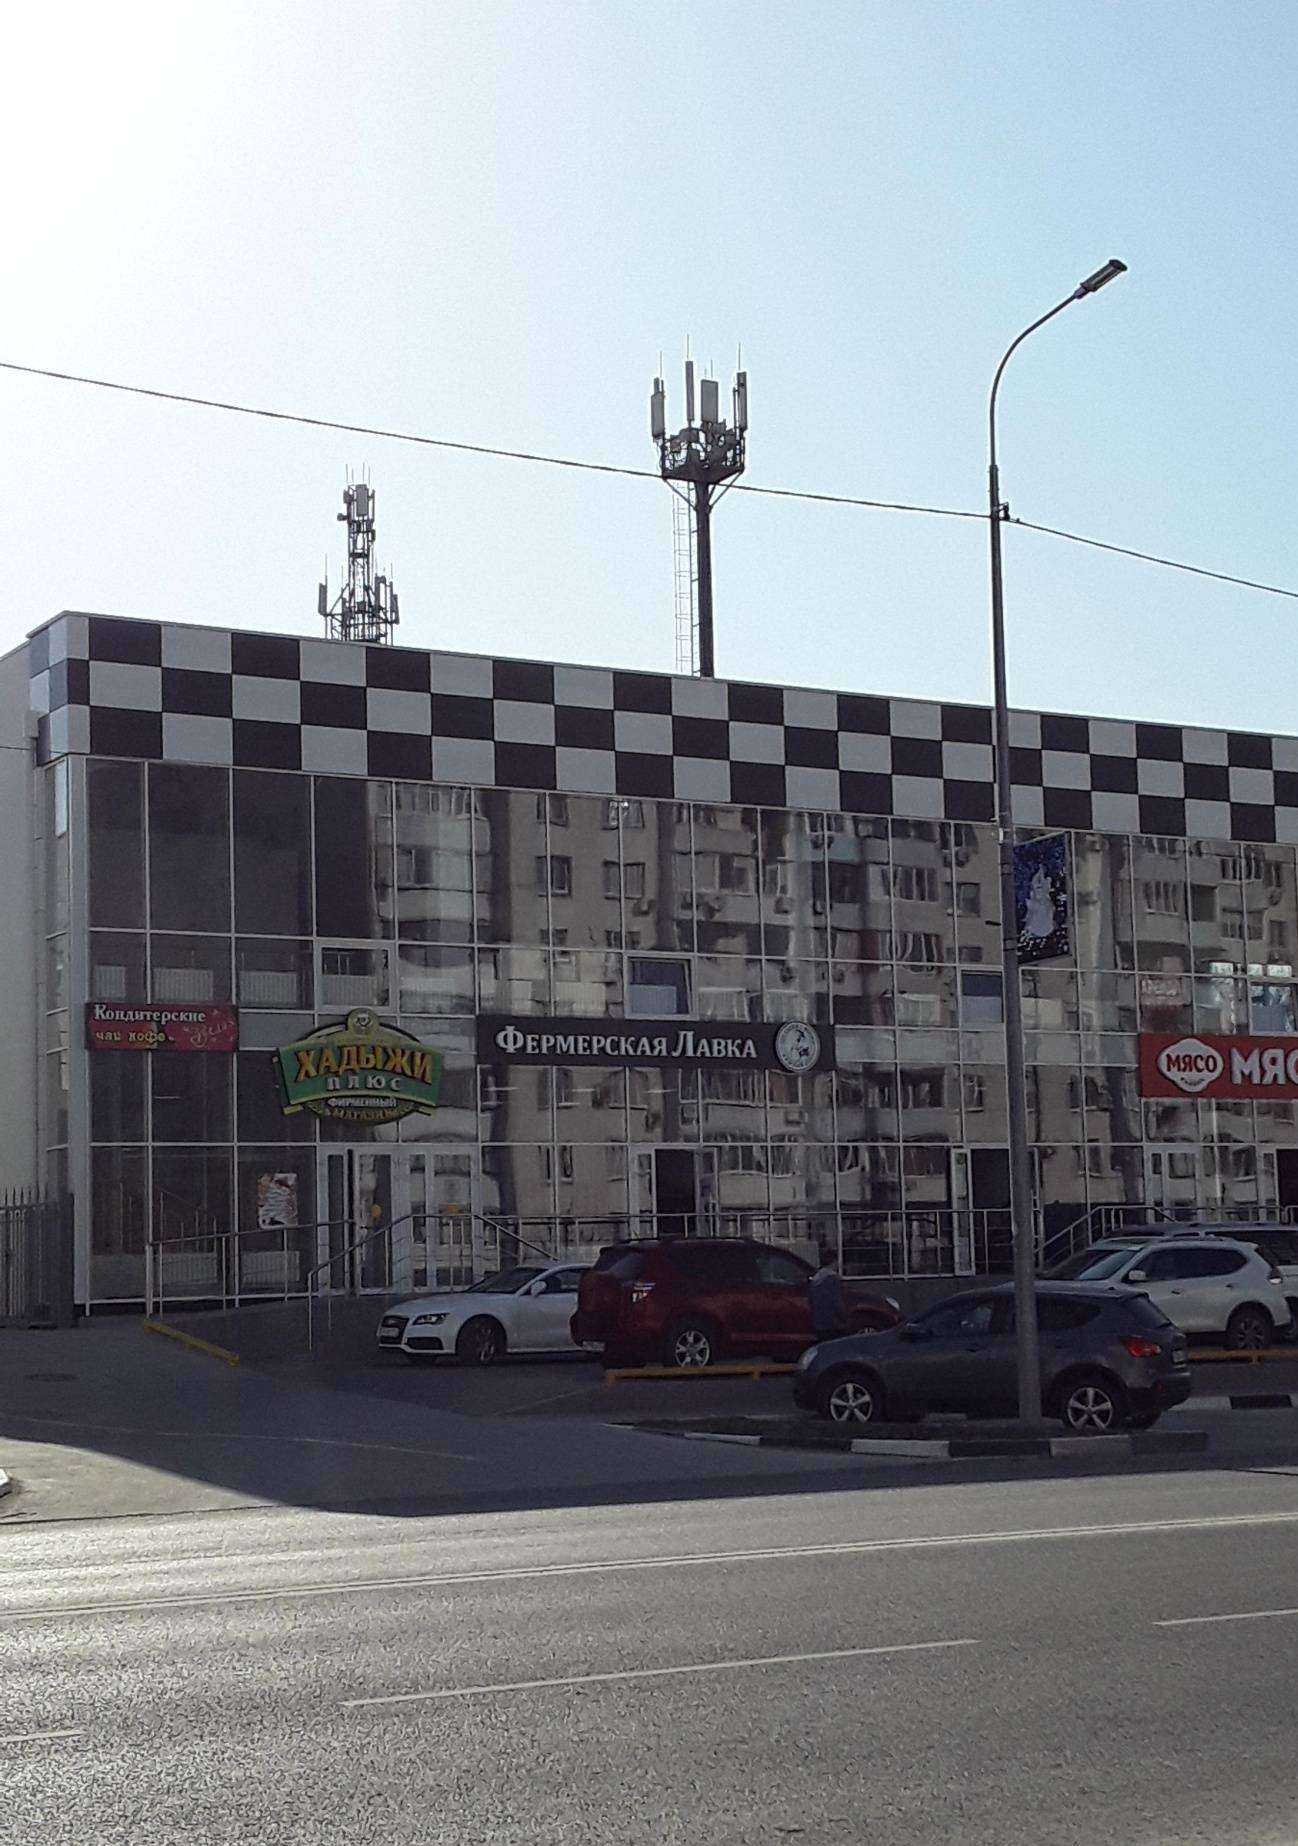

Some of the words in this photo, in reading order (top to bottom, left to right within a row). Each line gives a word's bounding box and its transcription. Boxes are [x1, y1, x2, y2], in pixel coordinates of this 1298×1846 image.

[94, 1004, 206, 1025] Кондитерские
[294, 1044, 432, 1086] ХАДЫЖИ
[1166, 1054, 1217, 1073] МЯСО
[326, 1074, 402, 1091] ПЛЮС
